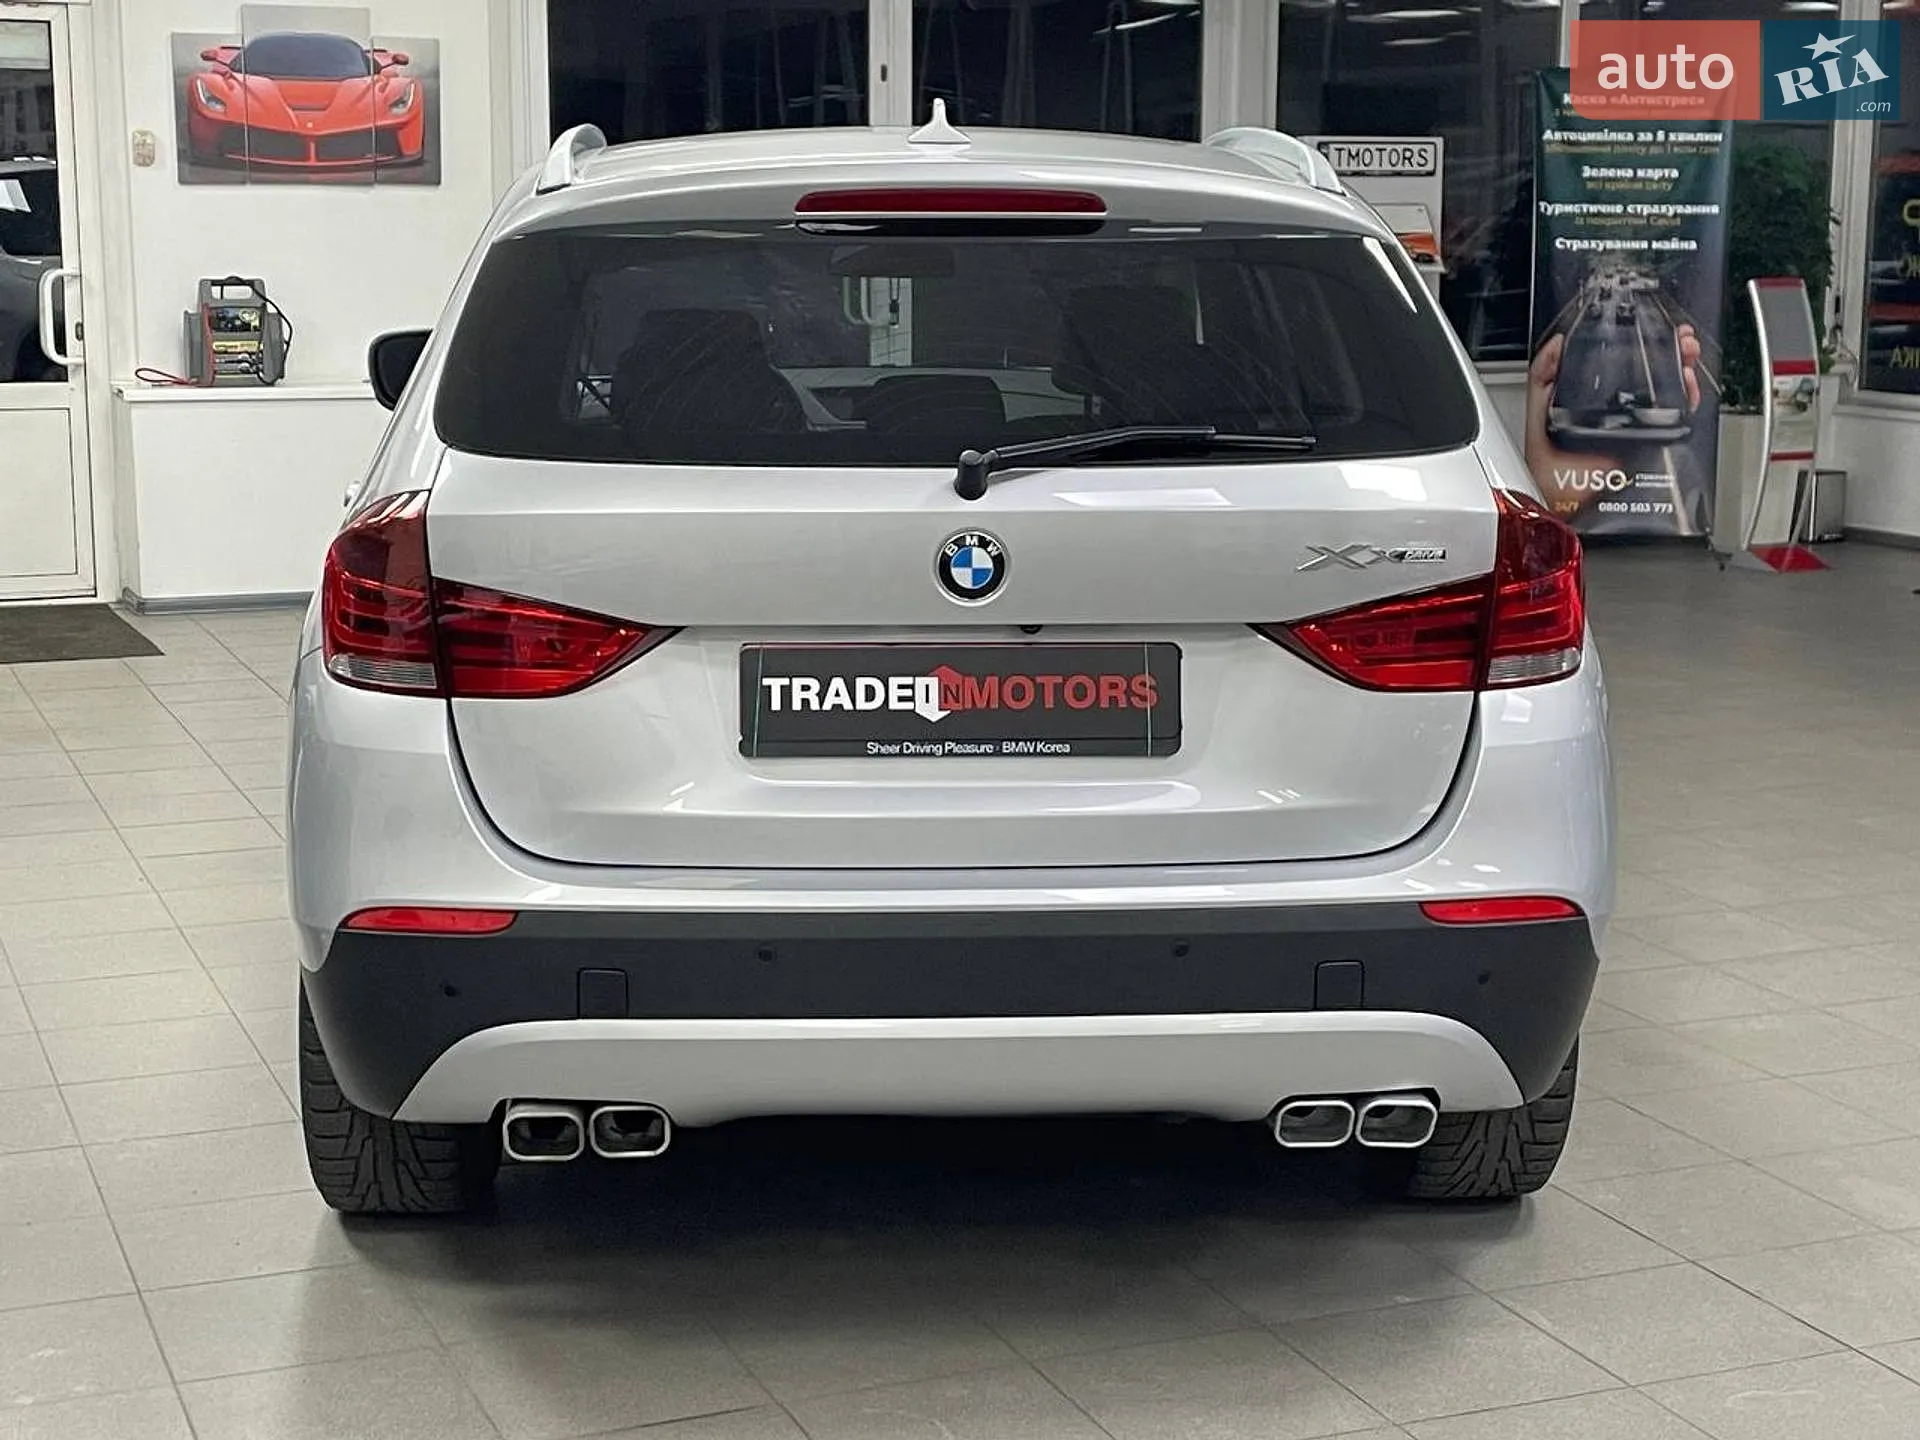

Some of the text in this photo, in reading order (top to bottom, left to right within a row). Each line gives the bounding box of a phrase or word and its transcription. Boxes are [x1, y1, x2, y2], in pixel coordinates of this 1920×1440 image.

[1582, 166, 1680, 180] Зелена карта
[1651, 238, 1698, 250] майна
[1553, 469, 1628, 491] VUSO
[944, 535, 1001, 557] BMW
[866, 741, 1071, 756] Sheer Driving Pleasure BMW Korea
